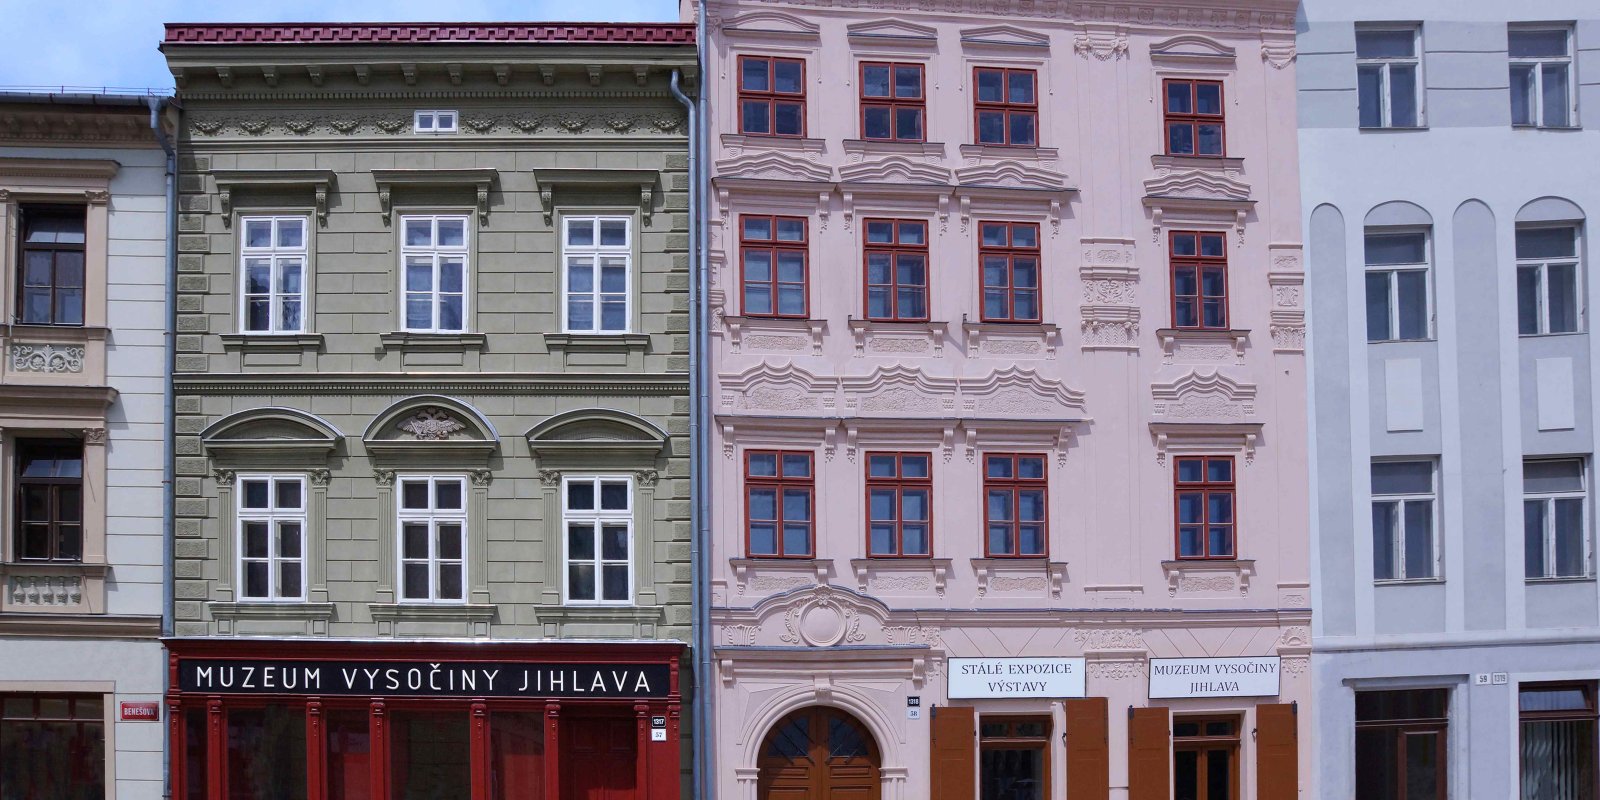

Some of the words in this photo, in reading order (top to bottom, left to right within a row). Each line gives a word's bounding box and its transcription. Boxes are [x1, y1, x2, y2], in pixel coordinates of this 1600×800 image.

[961, 661, 1003, 675] STÁLÉ
[1008, 663, 1072, 675] EXPOZICE
[1154, 663, 1210, 676] MUZEUM
[1215, 660, 1277, 674] VYSOČINY
[196, 666, 321, 690] MUZEUM
[342, 663, 499, 691] VYSOČINY
[518, 670, 651, 693] JIHLAVA
[1479, 675, 1488, 683] 59
[1494, 674, 1506, 682] 1319
[988, 679, 1047, 692] VÝSTAVY
[1189, 681, 1240, 694] JIHLAVA
[124, 706, 155, 716] BENEŠOVA
